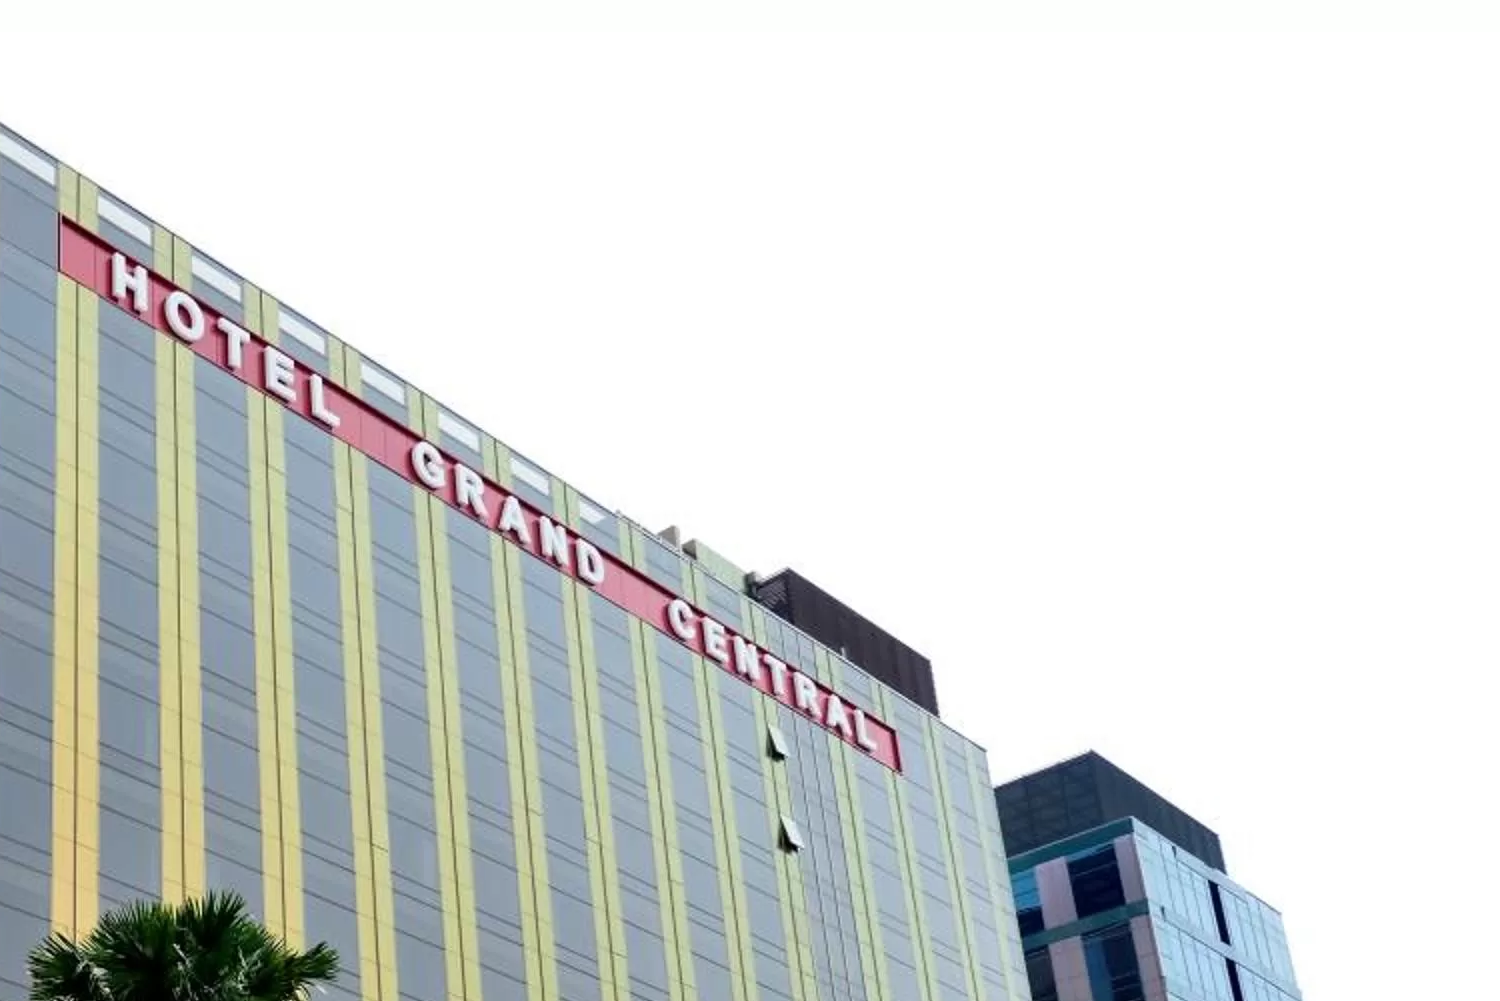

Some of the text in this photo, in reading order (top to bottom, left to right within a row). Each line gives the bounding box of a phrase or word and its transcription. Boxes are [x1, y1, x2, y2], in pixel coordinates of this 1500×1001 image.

[110, 252, 879, 752] HOTEL GRAND CENTRAL
